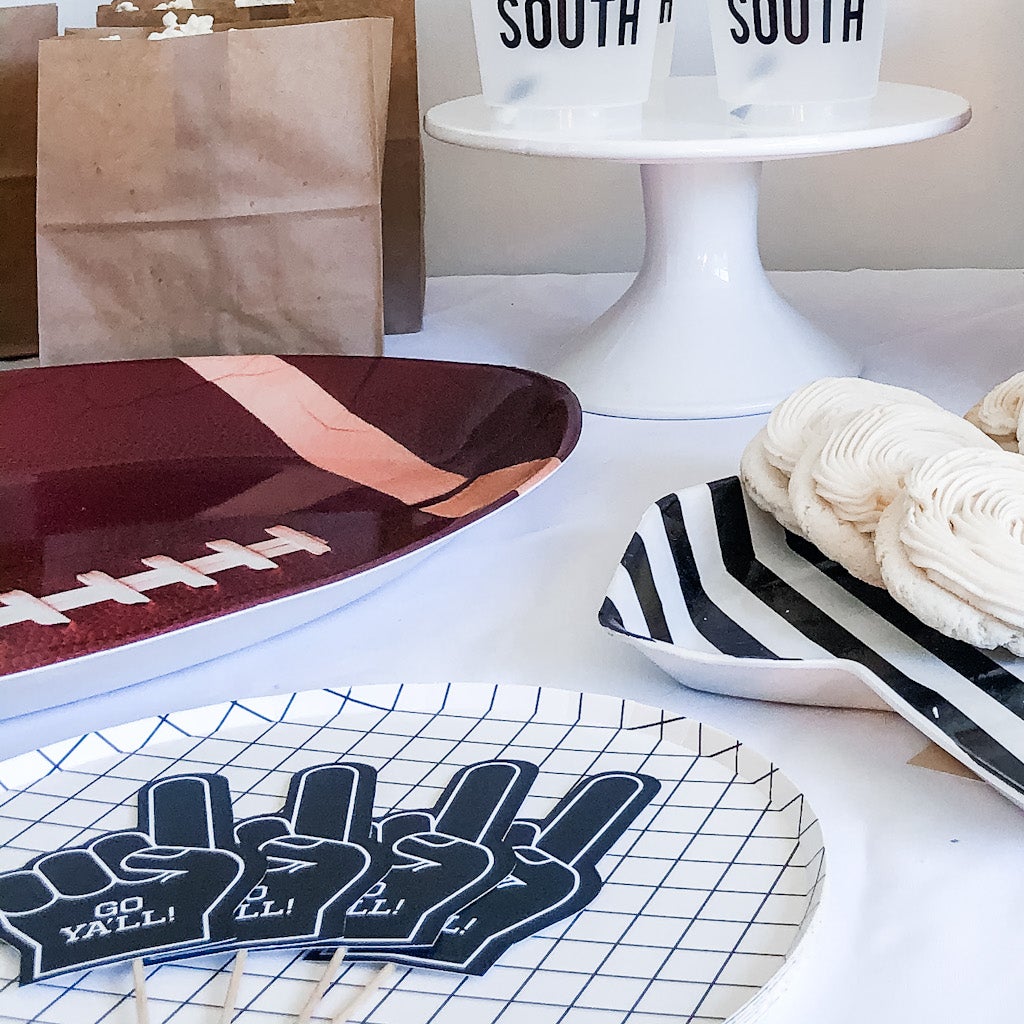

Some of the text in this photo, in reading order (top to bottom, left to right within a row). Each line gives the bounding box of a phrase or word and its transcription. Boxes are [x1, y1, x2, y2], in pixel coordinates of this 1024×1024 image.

[94, 896, 144, 919] GO
[235, 898, 295, 921] LL!
[346, 899, 405, 916] LL!
[59, 906, 175, 944] YA'LL!
